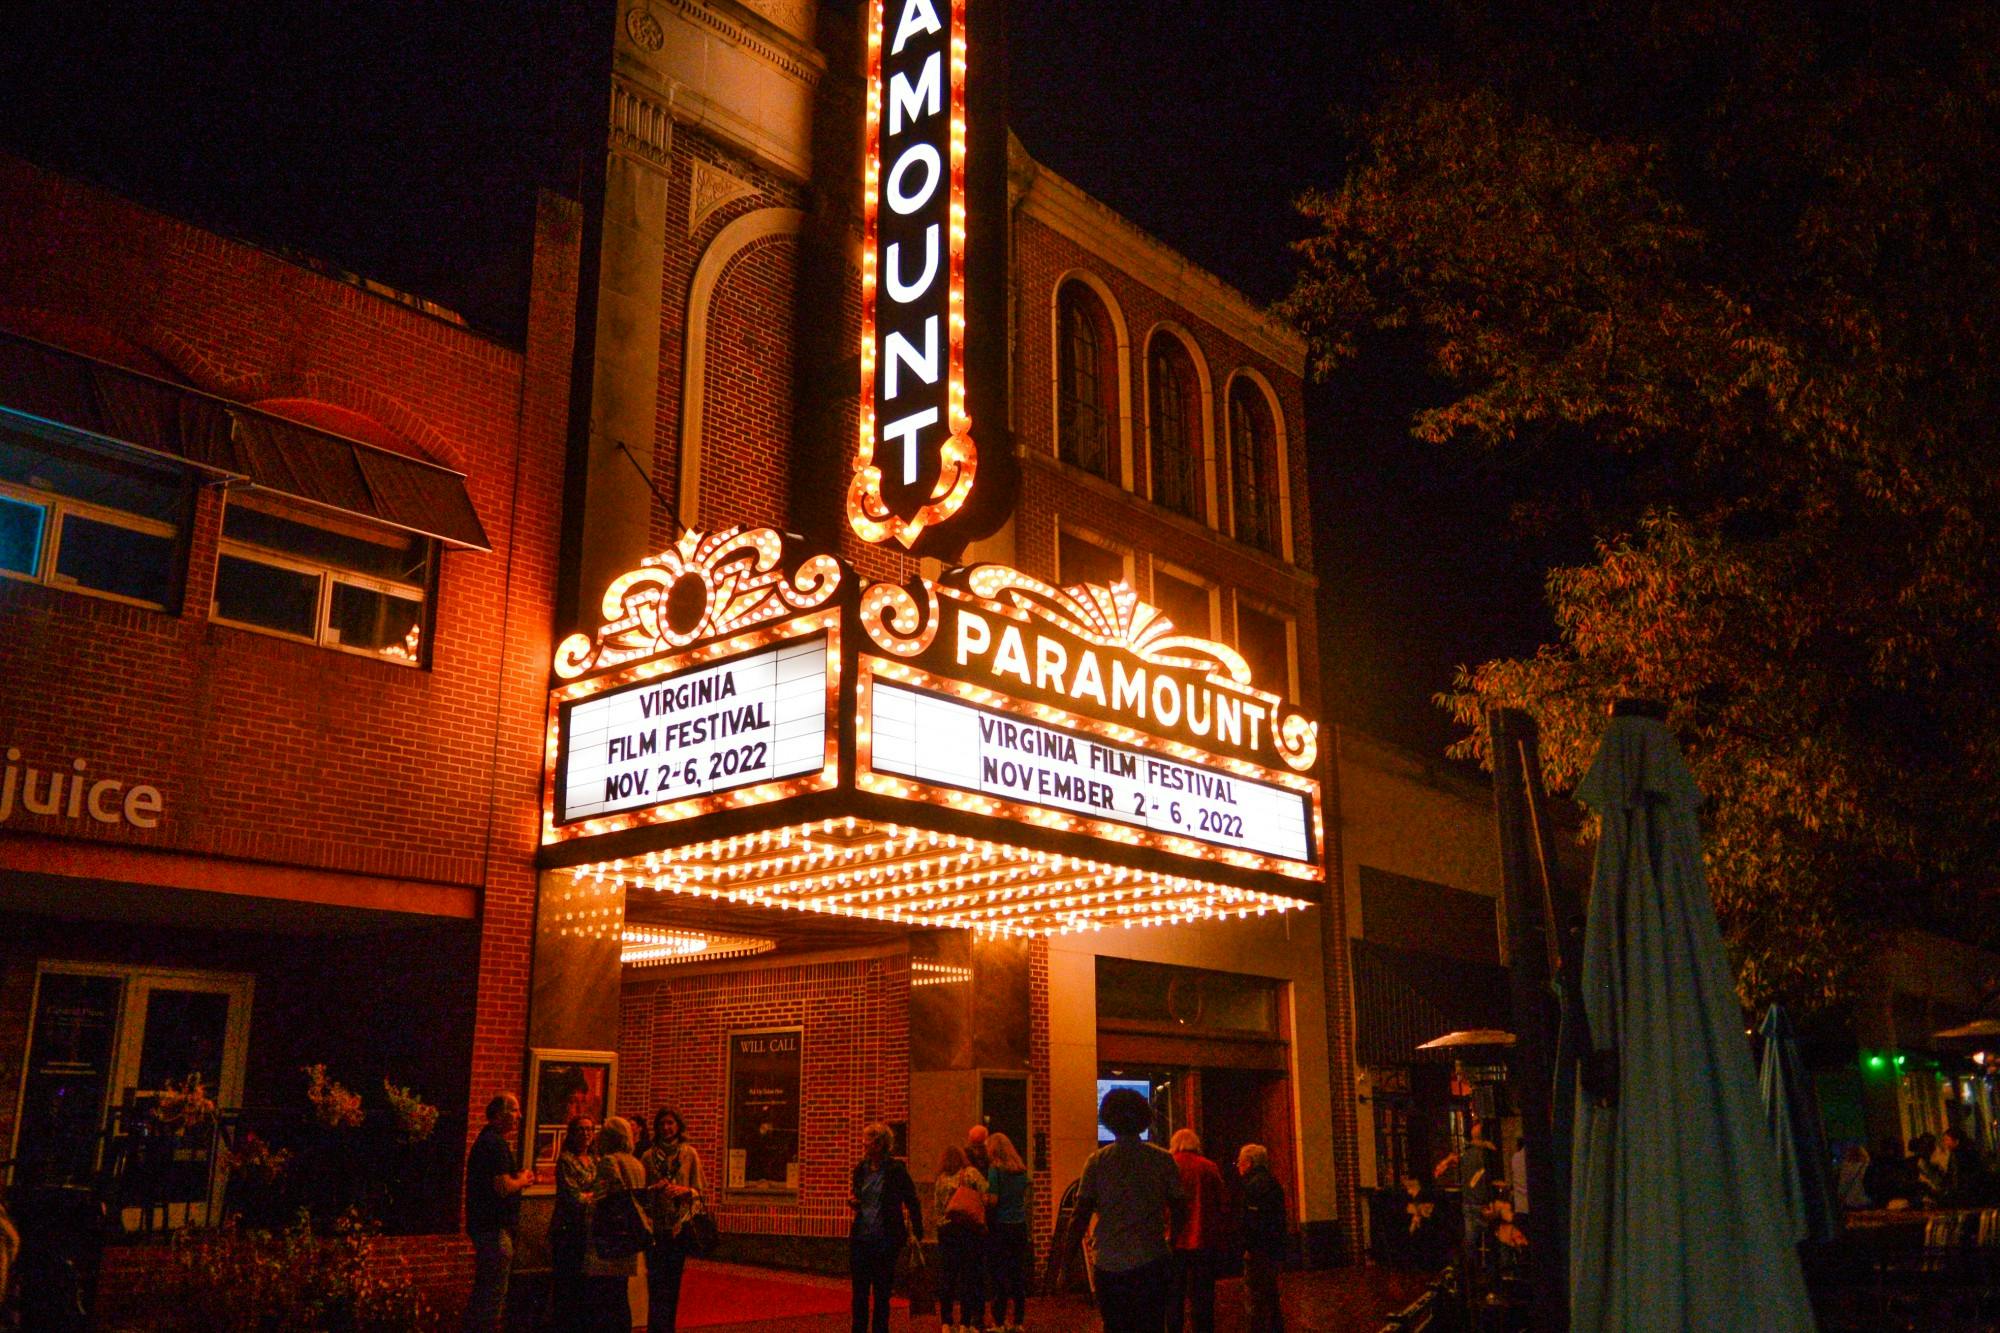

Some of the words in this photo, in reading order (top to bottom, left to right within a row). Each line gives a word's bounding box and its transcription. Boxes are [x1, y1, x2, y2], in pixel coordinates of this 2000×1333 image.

[639, 671, 736, 718] VIRGINIA
[957, 609, 1266, 751] PARAMOUNT
[608, 728, 657, 764] FILM
[665, 702, 770, 751] FESTIVAL
[978, 715, 1078, 765] VIRGINIA
[1090, 744, 1137, 780] FILM
[1147, 760, 1237, 805] FESTIVAL
[0, 748, 163, 829] juice
[605, 768, 649, 802] NOV.
[657, 757, 702, 792] 2-6,
[709, 741, 767, 780] 2022
[983, 755, 1114, 810] NOVEMBER
[1198, 808, 1244, 839] 2022
[741, 1040, 766, 1053] WILL
[770, 1039, 796, 1052] CALL
